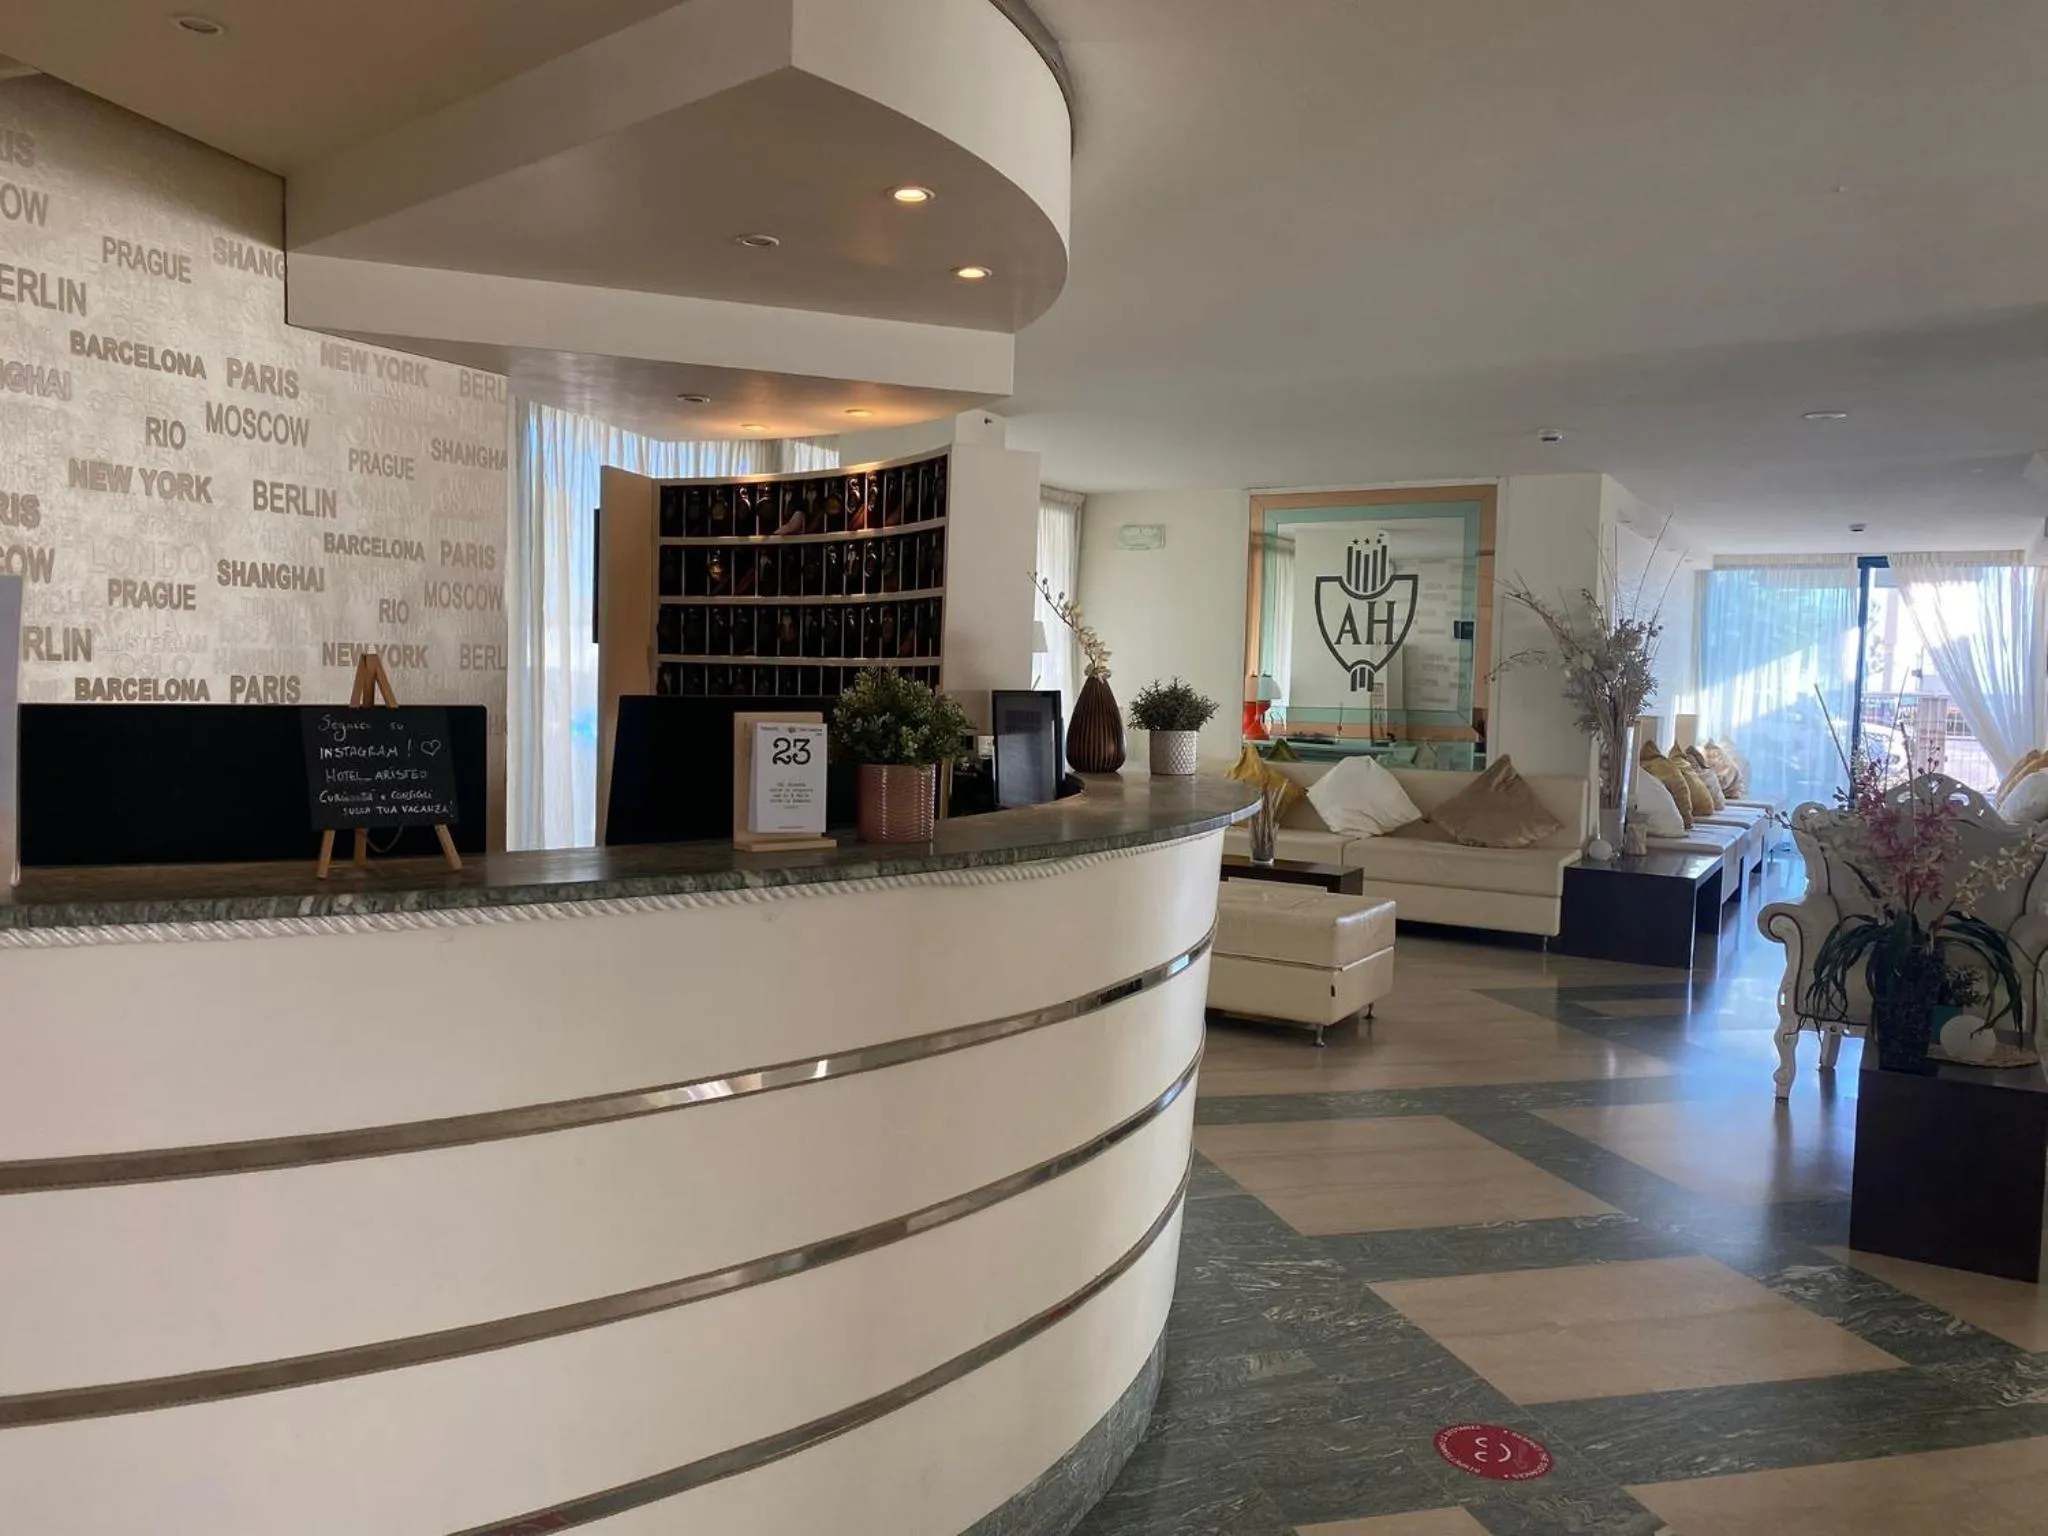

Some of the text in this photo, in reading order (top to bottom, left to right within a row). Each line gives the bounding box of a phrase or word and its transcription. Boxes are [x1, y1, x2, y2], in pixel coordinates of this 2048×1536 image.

[102, 236, 192, 284] PRAGUE
[212, 237, 286, 281] SHANG
[69, 329, 207, 380] BARCELONA
[319, 340, 429, 388] NEW YORK
[0, 358, 72, 402] GHAI
[226, 357, 300, 399] PARIS
[146, 416, 187, 450] RIO
[205, 401, 310, 448] MOSCOW
[68, 457, 213, 504] NEW YORK
[349, 447, 415, 481] PRAGUE
[253, 479, 337, 519] BERLIN
[324, 531, 426, 563] BARCELONA
[440, 540, 496, 571] PARIS
[217, 558, 325, 592] SHANGHAI
[107, 578, 197, 611] PRAGUE
[378, 598, 410, 624] RIO
[423, 580, 503, 611] MOSCOW
[1333, 600, 1397, 645] AH
[22, 626, 92, 662] RLIN
[75, 677, 210, 702] BARCELONA
[230, 675, 301, 704] PARIS
[320, 745, 398, 760] INSTAGRAM
[772, 737, 811, 765] 23
